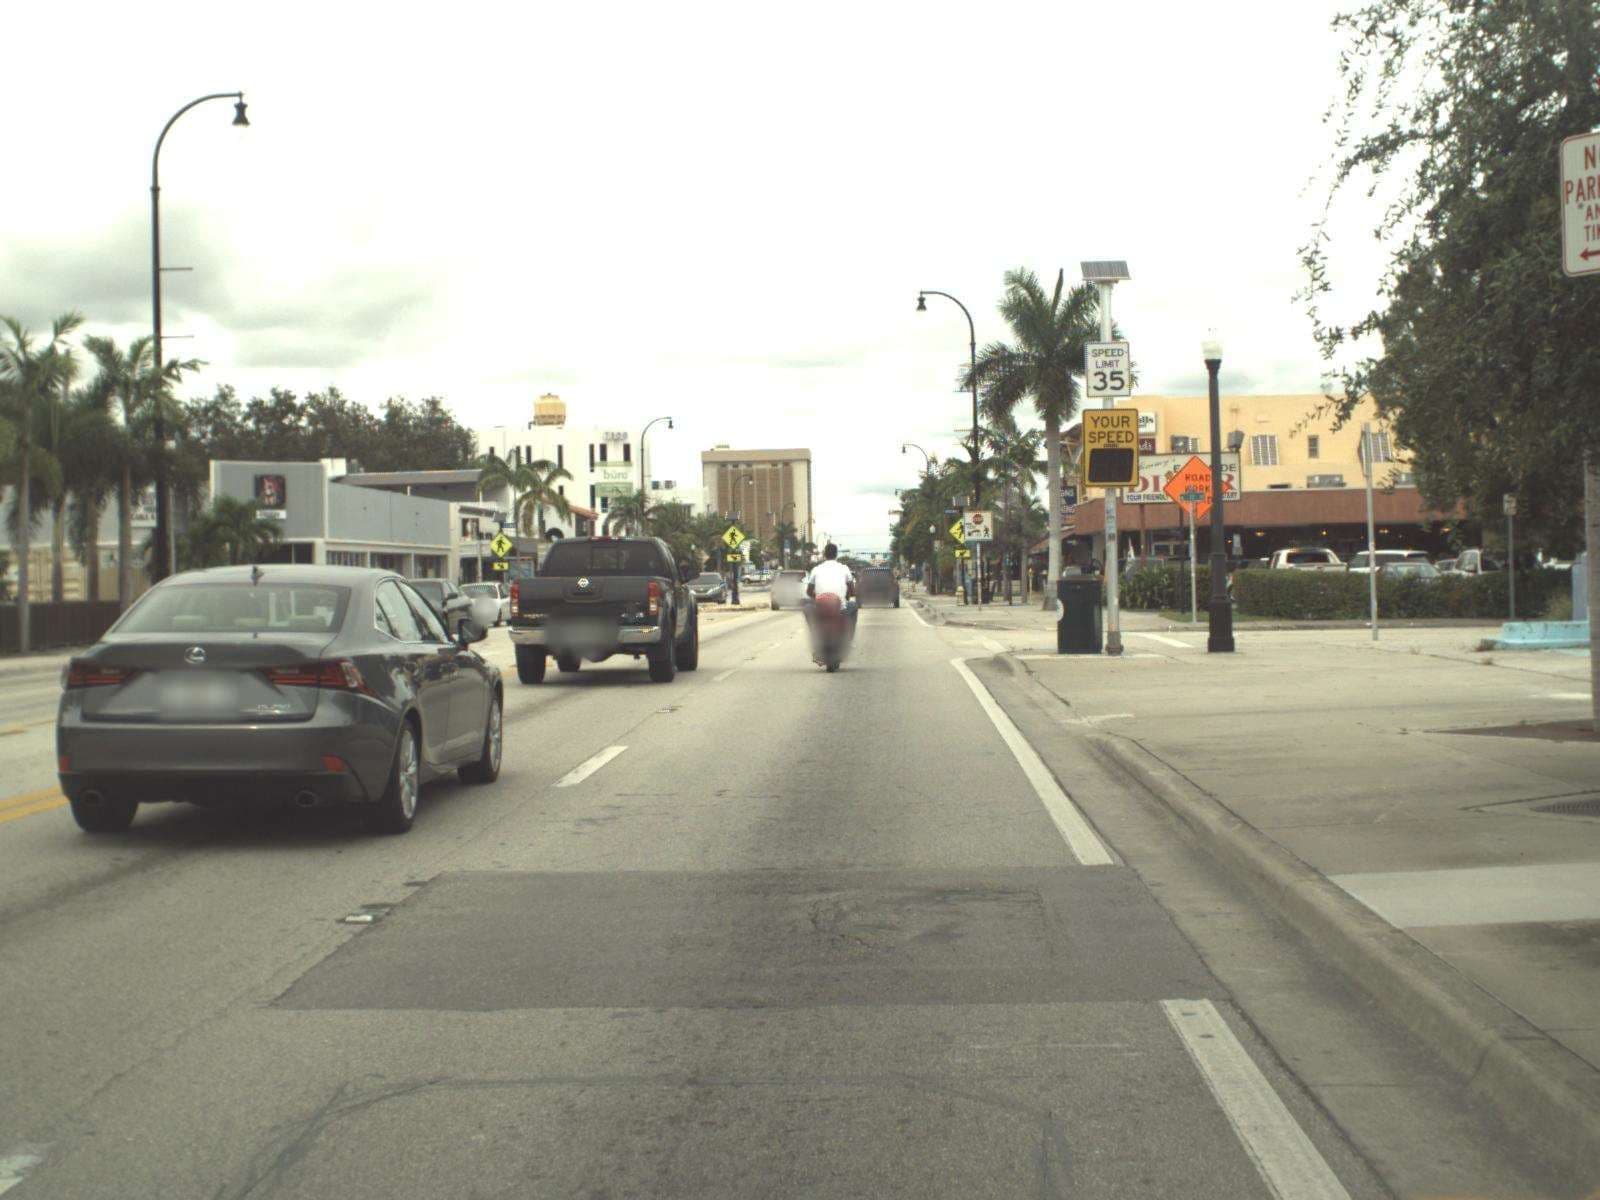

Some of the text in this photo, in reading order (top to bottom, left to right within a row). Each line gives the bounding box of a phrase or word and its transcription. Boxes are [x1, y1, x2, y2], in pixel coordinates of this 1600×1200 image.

[1584, 144, 1600, 170] N
[1564, 173, 1600, 205] PAR
[1091, 348, 1124, 358] SPEED
[1095, 359, 1120, 369] LIMIT
[1093, 370, 1125, 391] 35
[1090, 415, 1130, 429] YOUR
[1088, 431, 1135, 444] SPEED
